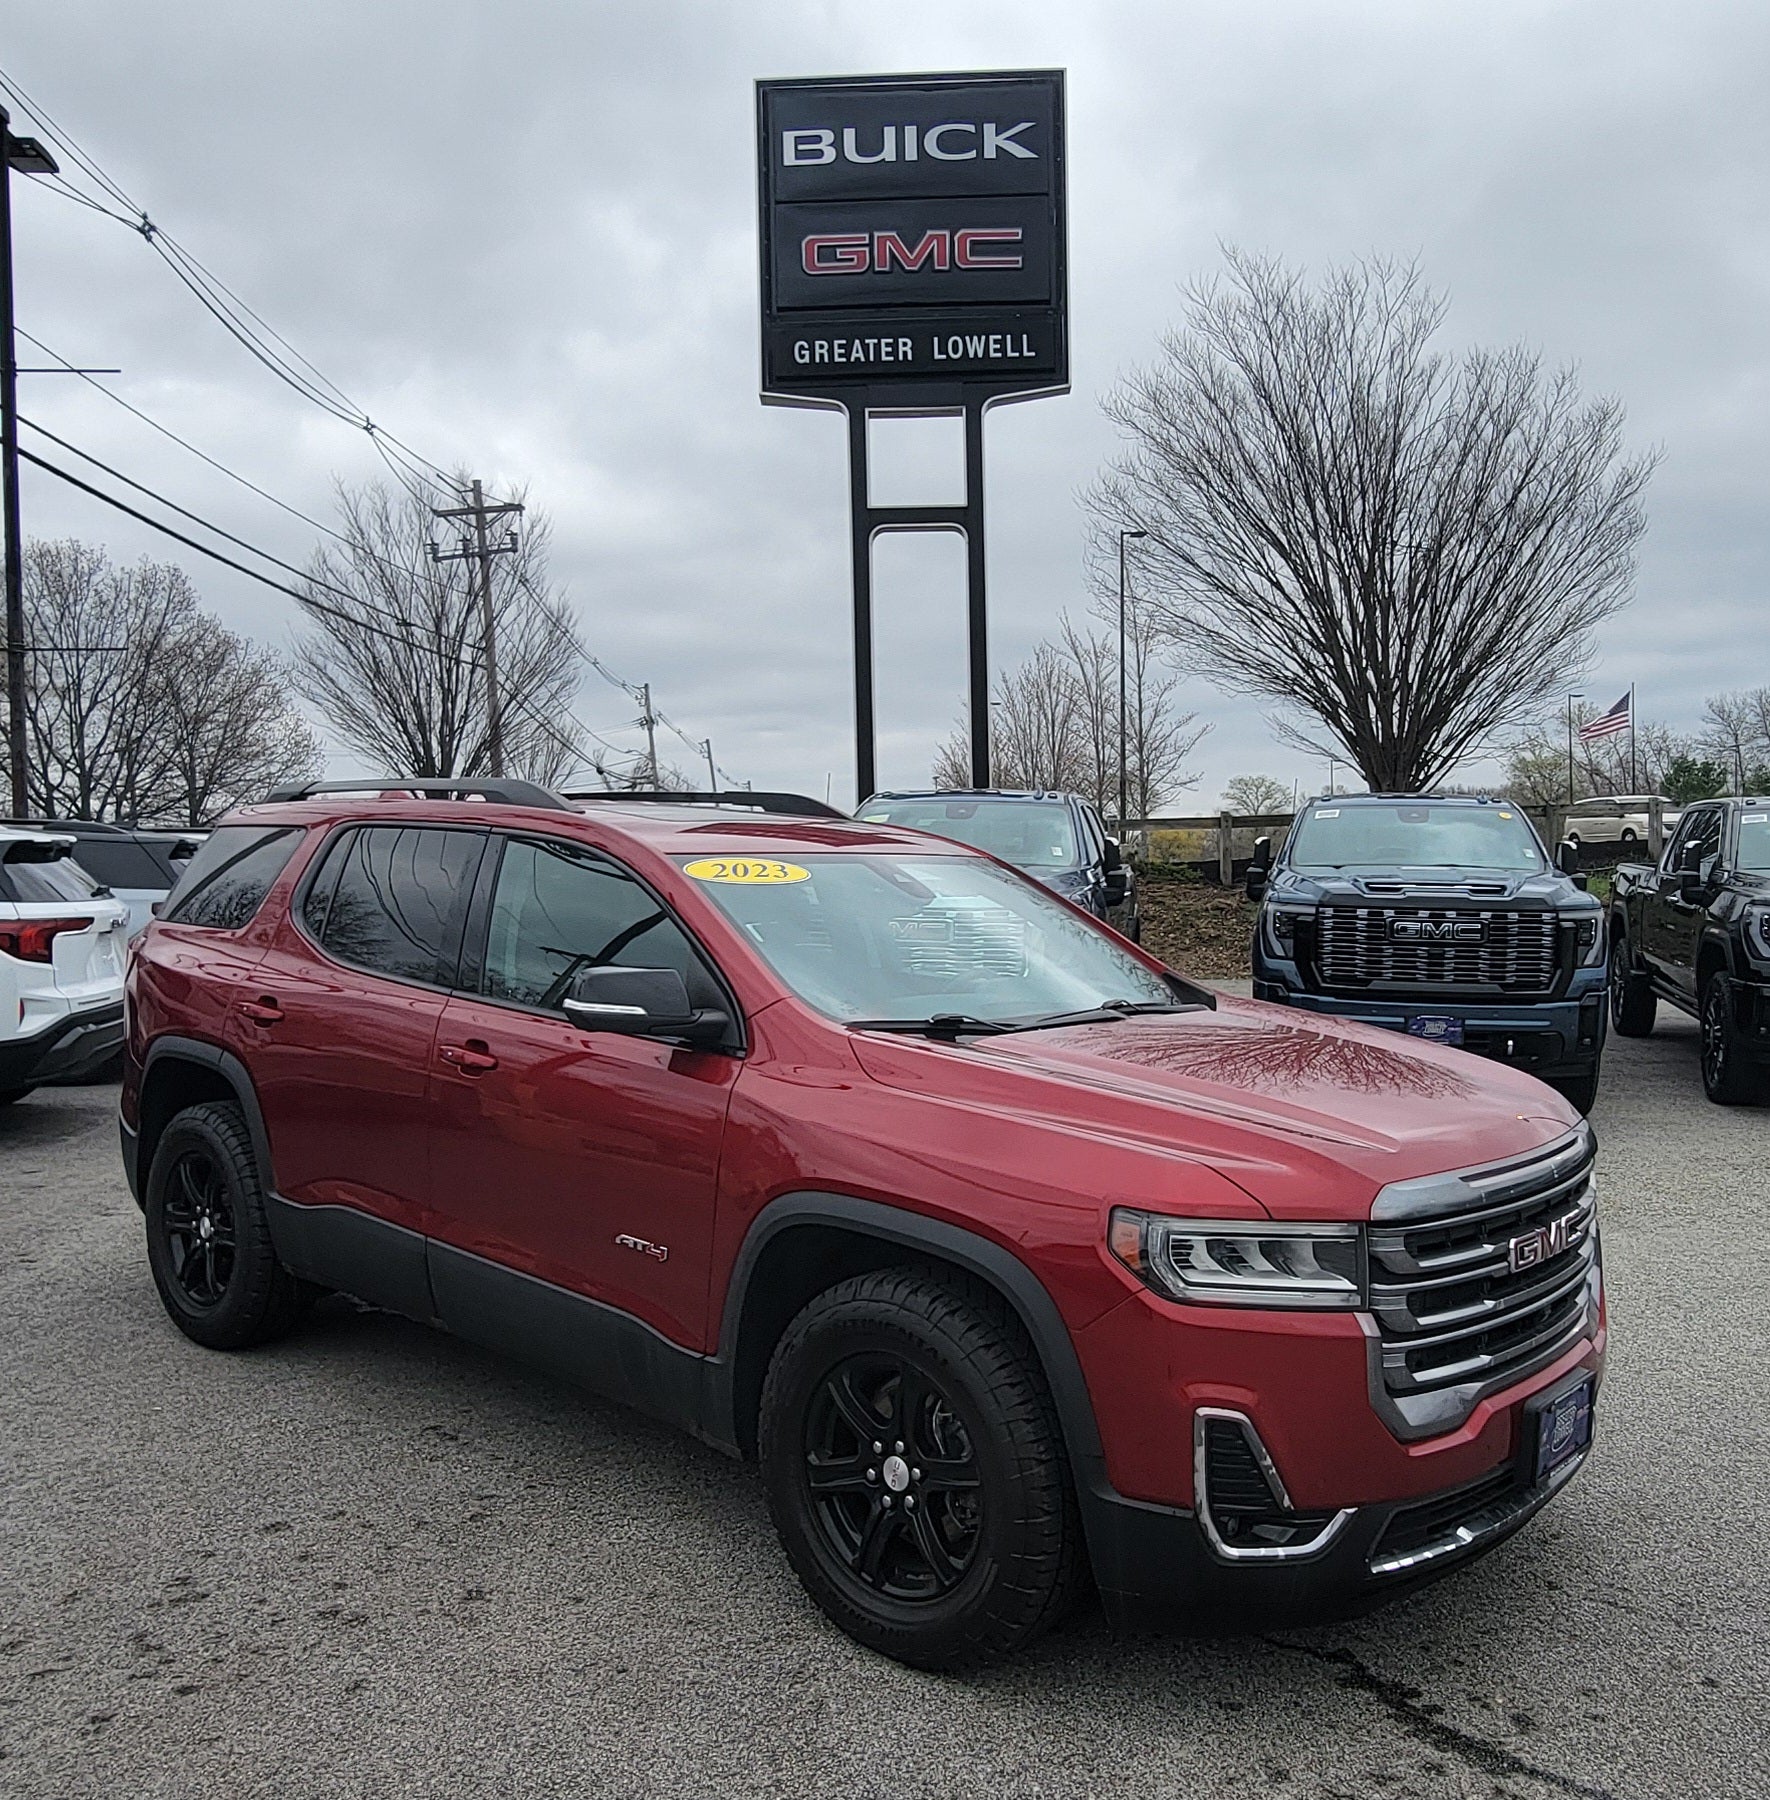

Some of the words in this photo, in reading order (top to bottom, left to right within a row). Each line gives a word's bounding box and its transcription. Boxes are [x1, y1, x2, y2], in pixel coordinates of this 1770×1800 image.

[782, 122, 1040, 166] BUICK
[802, 228, 1023, 275] GMC
[793, 337, 914, 364] GREATER
[932, 334, 1036, 361] LOWELL
[710, 863, 789, 878] 2023
[1394, 922, 1481, 939] GMC
[615, 1233, 668, 1262] AT4
[1509, 1208, 1582, 1274] GMC
